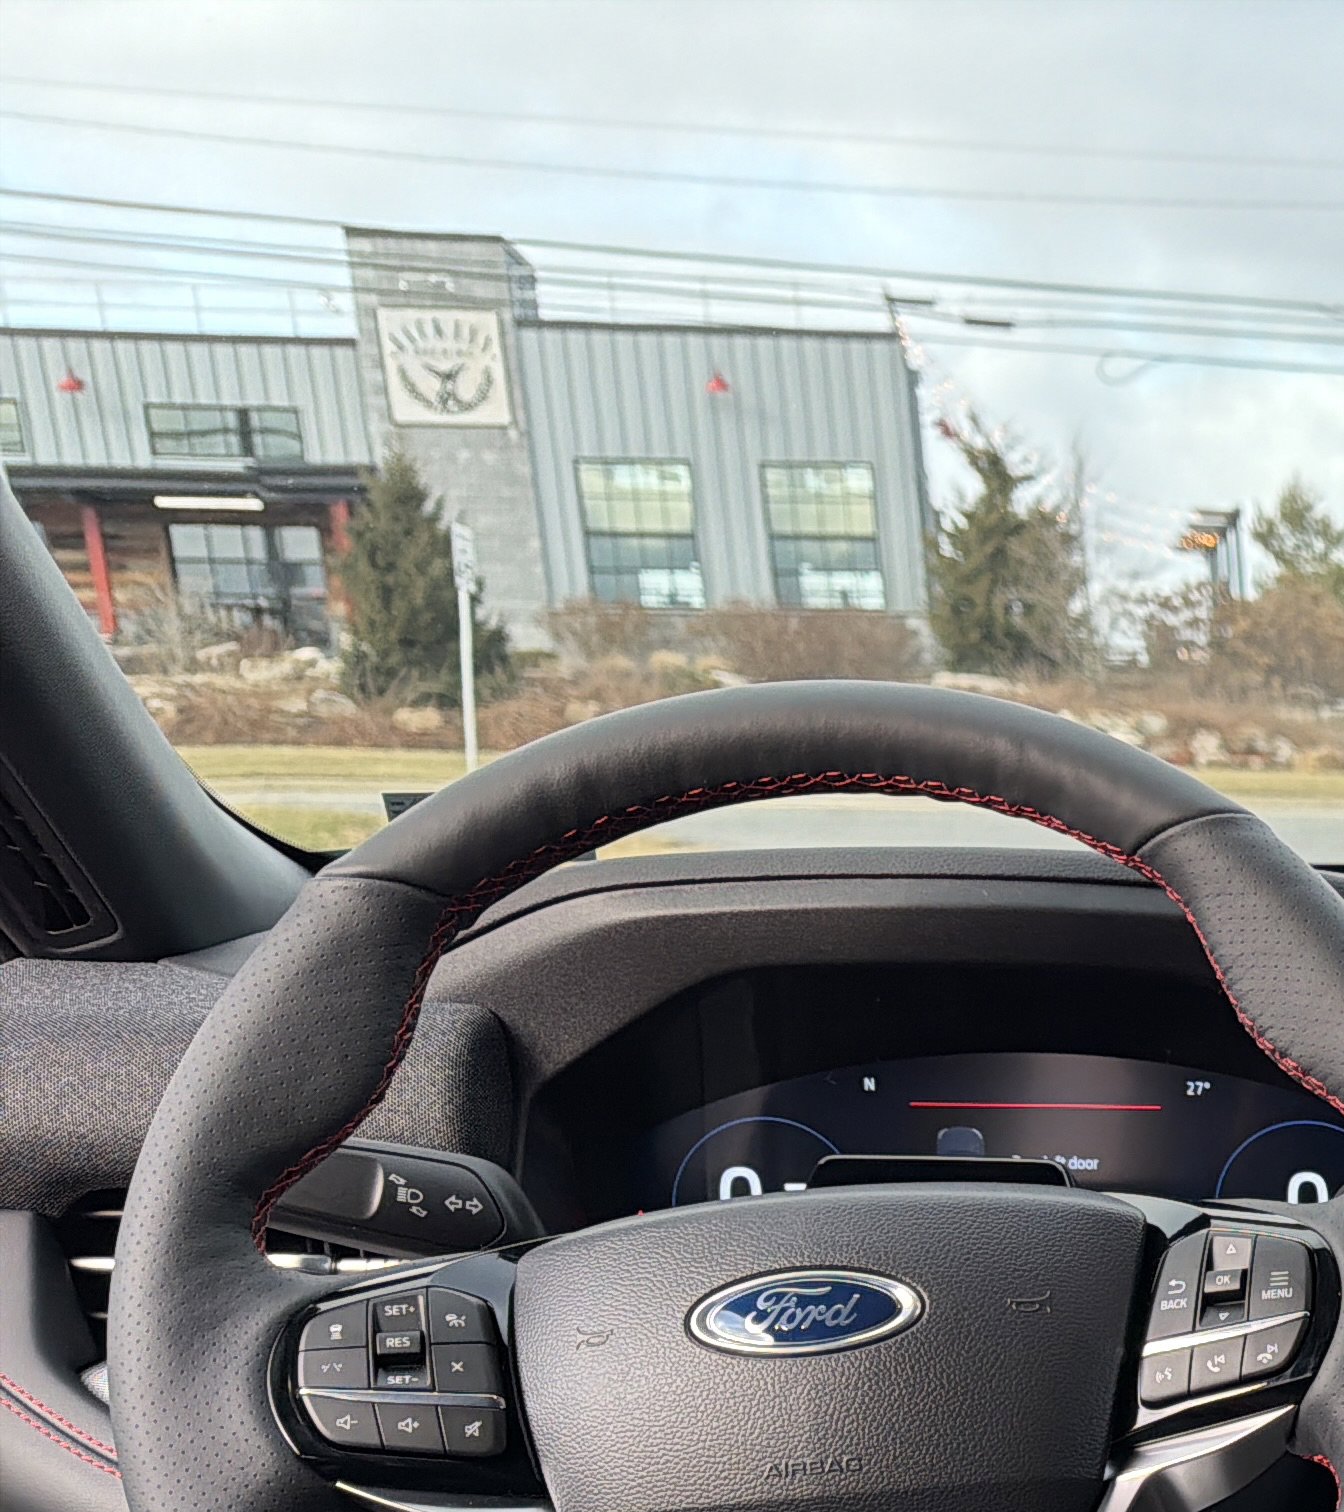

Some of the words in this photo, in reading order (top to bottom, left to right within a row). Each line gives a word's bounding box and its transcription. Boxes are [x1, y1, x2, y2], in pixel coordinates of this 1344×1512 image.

[863, 1077, 875, 1092] N
[1067, 1155, 1100, 1170] door
[1215, 1274, 1231, 1286] OK
[1261, 1287, 1293, 1300] MENU
[383, 1303, 416, 1318] SET+
[744, 1285, 861, 1334] Ford
[1160, 1298, 1188, 1310] BACK
[385, 1336, 411, 1349] RES
[386, 1374, 419, 1385] SET-
[763, 1455, 864, 1481] AIRBAG
